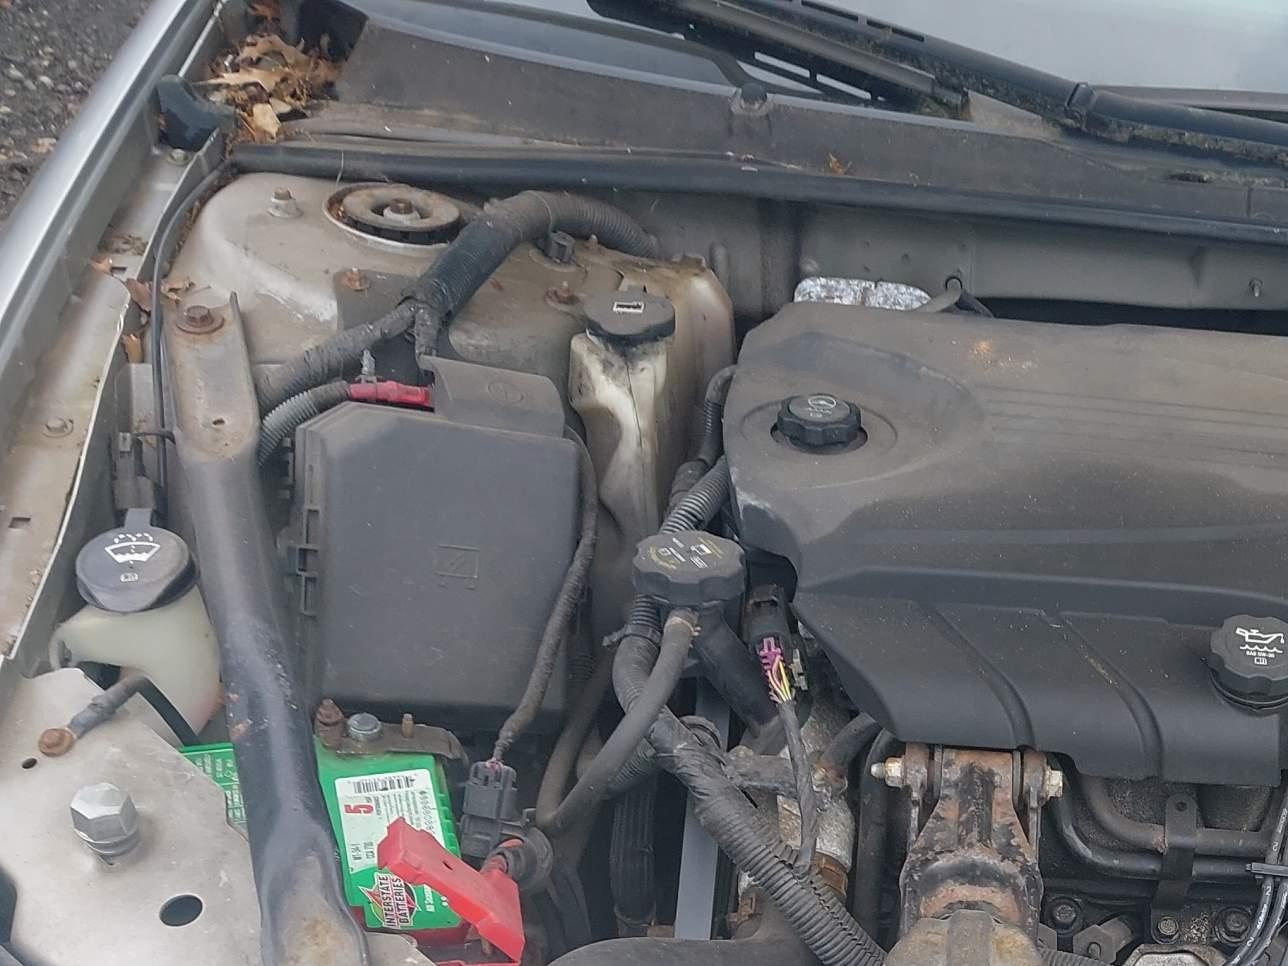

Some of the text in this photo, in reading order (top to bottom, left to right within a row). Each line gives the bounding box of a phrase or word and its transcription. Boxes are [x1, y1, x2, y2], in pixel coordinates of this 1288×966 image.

[344, 804, 374, 814] 5
[378, 875, 396, 927] INTERSTATE
[391, 877, 409, 924] BATTERIES
